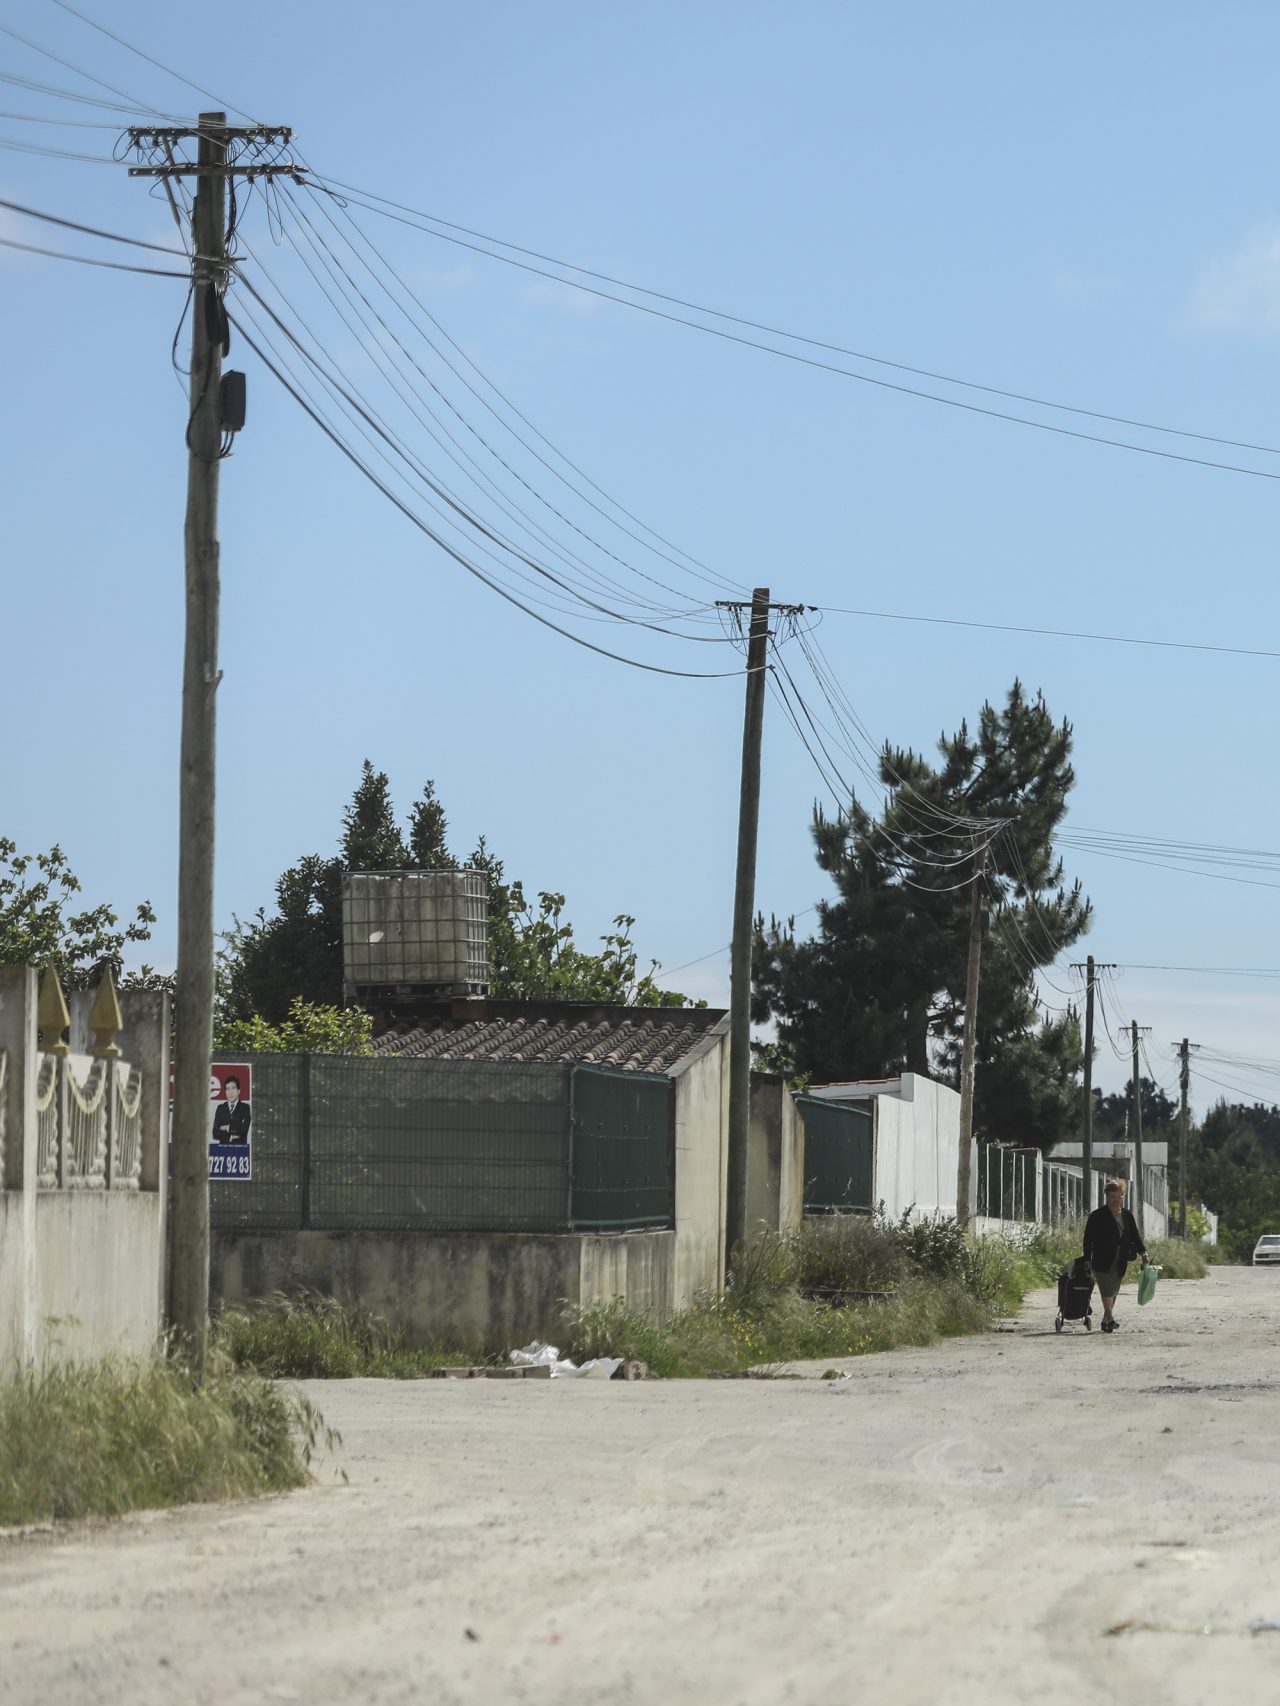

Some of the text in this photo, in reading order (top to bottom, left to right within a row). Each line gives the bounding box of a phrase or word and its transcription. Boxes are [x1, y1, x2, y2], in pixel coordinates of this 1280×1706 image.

[208, 1156, 249, 1174] 727 92 83
